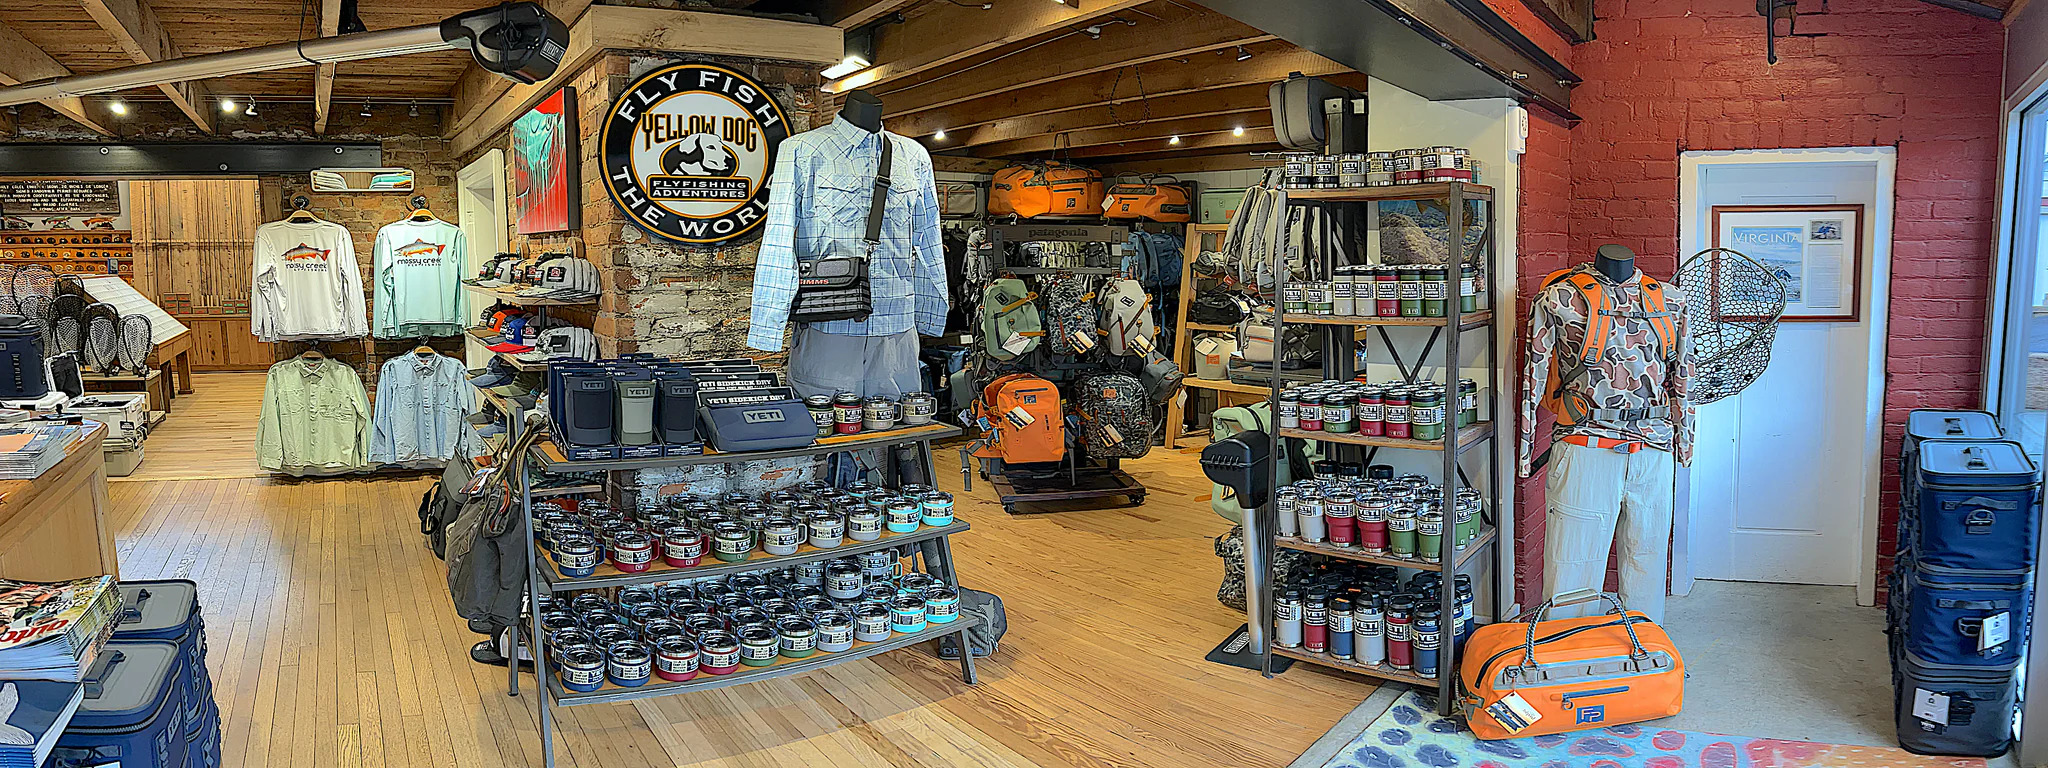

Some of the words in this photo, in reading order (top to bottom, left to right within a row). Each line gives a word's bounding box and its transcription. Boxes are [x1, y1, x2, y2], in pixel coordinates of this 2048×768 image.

[617, 71, 680, 123] FLY
[699, 70, 780, 128] FISH
[640, 112, 717, 153] YELLOW
[722, 115, 757, 153] DOG
[652, 180, 747, 189] FLYFISHING
[612, 165, 666, 227] THE
[652, 189, 746, 198] ADVENTURES
[1028, 228, 1089, 238] patagonia
[1733, 232, 1801, 244] VIRGINIA
[717, 379, 755, 387] SIDEKICK
[728, 395, 769, 403] SIDEKICK
[747, 411, 781, 420] YETI
[1326, 503, 1348, 511] YETI
[1356, 620, 1378, 629] YETI
[943, 647, 983, 655] ORIS
